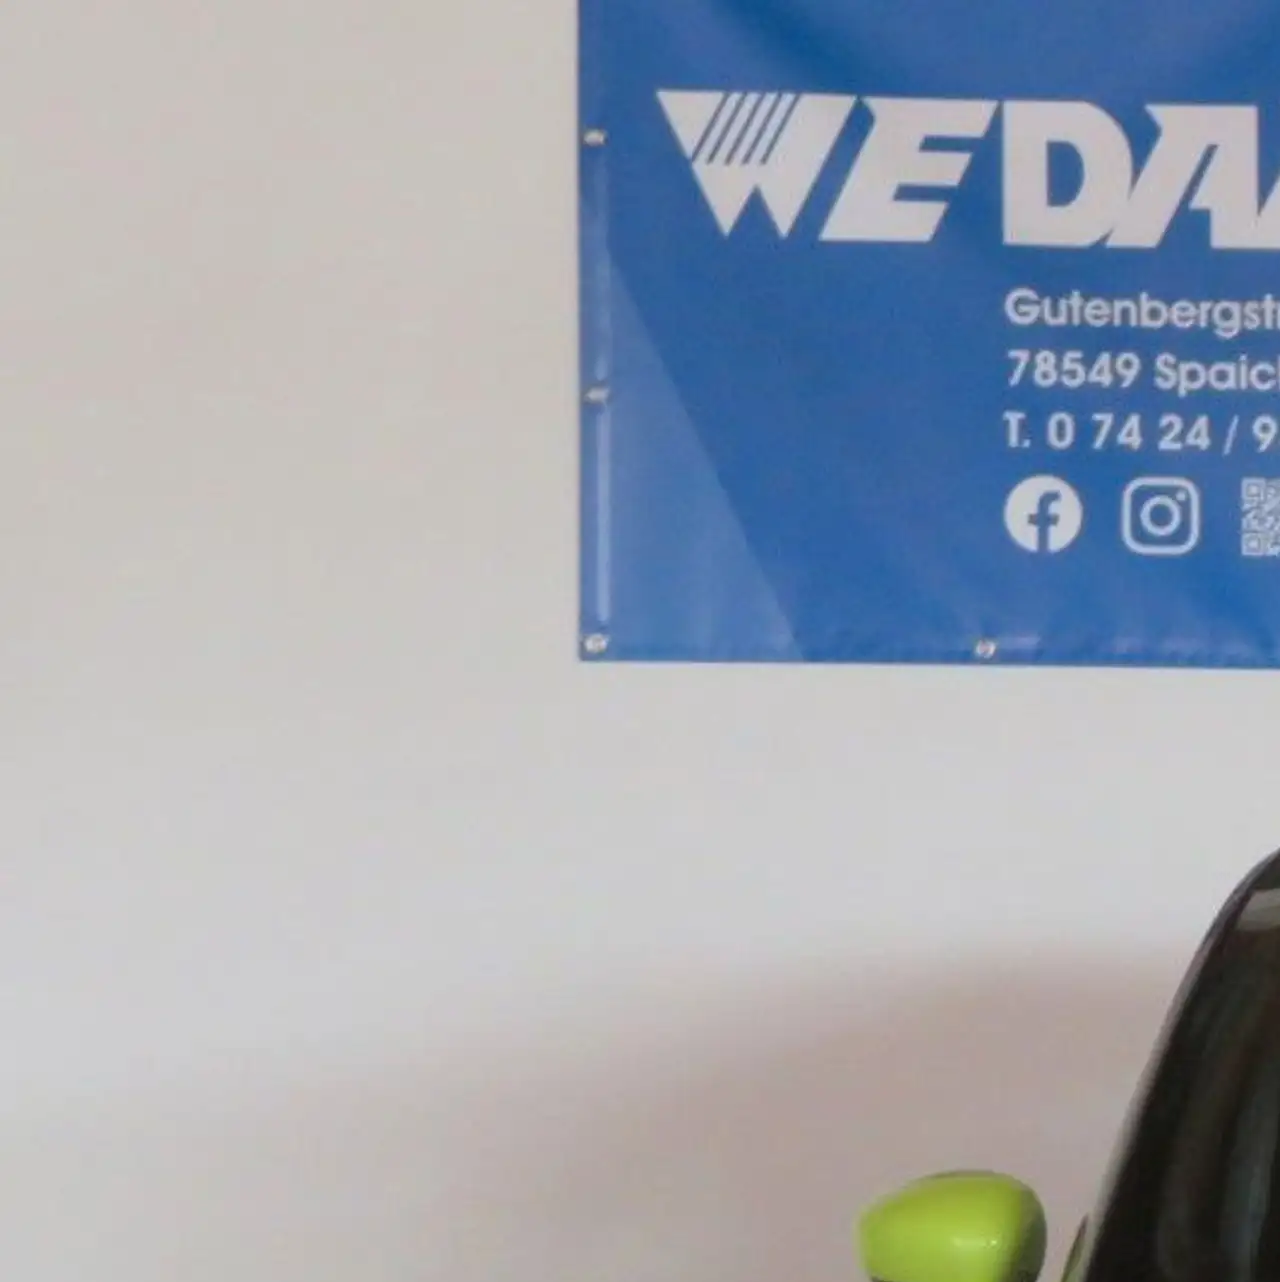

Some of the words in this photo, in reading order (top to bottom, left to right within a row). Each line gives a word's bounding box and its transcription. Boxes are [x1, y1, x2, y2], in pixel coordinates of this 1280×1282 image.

[1008, 349, 1141, 388] 78549
[1004, 411, 1031, 448] T.
[1093, 413, 1143, 451] 74
[1159, 414, 1211, 452] 24
